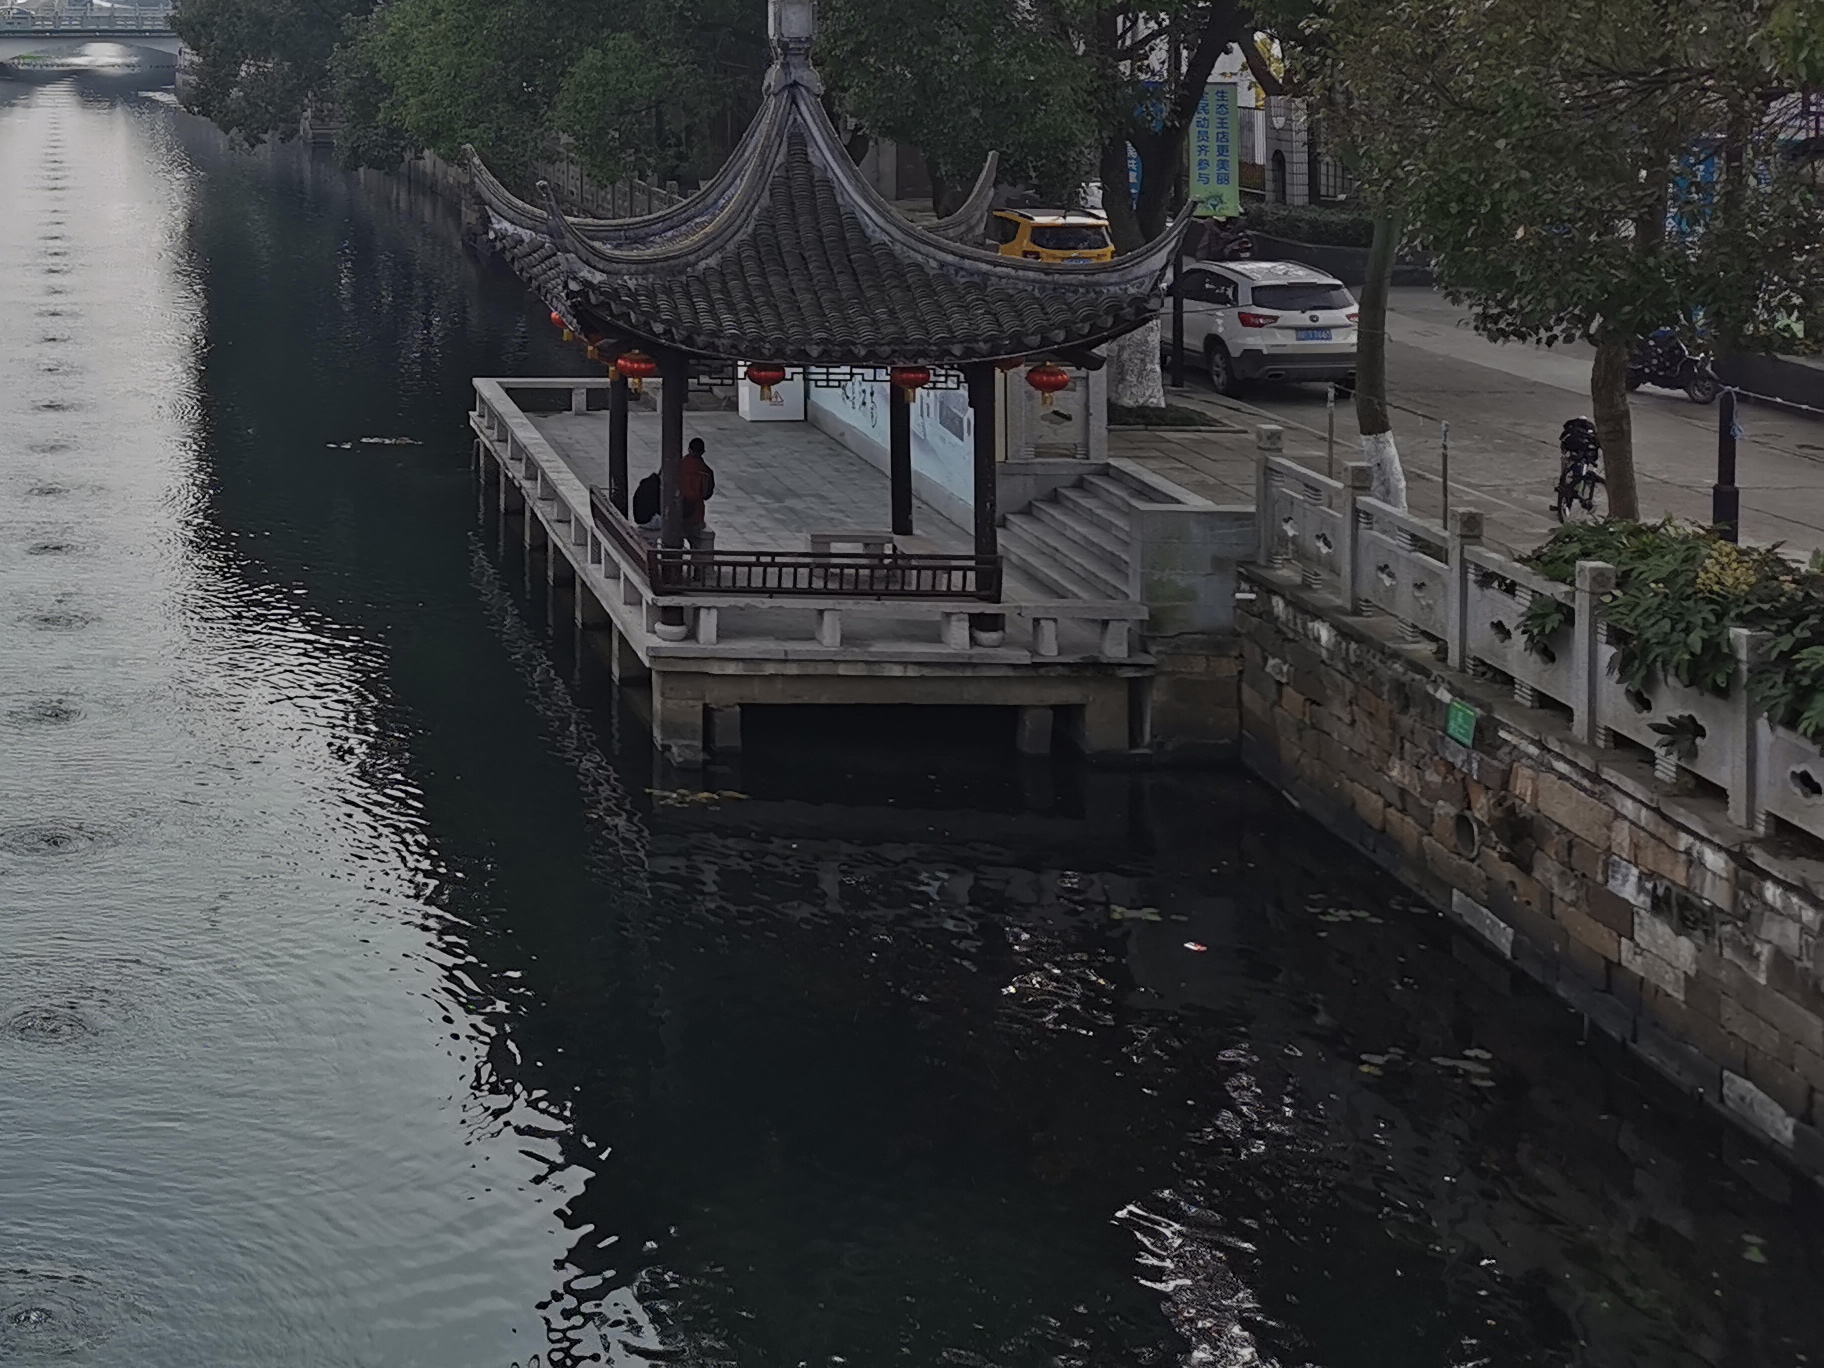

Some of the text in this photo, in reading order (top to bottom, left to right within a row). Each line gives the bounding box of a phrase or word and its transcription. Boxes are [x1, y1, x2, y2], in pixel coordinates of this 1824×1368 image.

[1215, 89, 1231, 185] 生态王店更美丽
